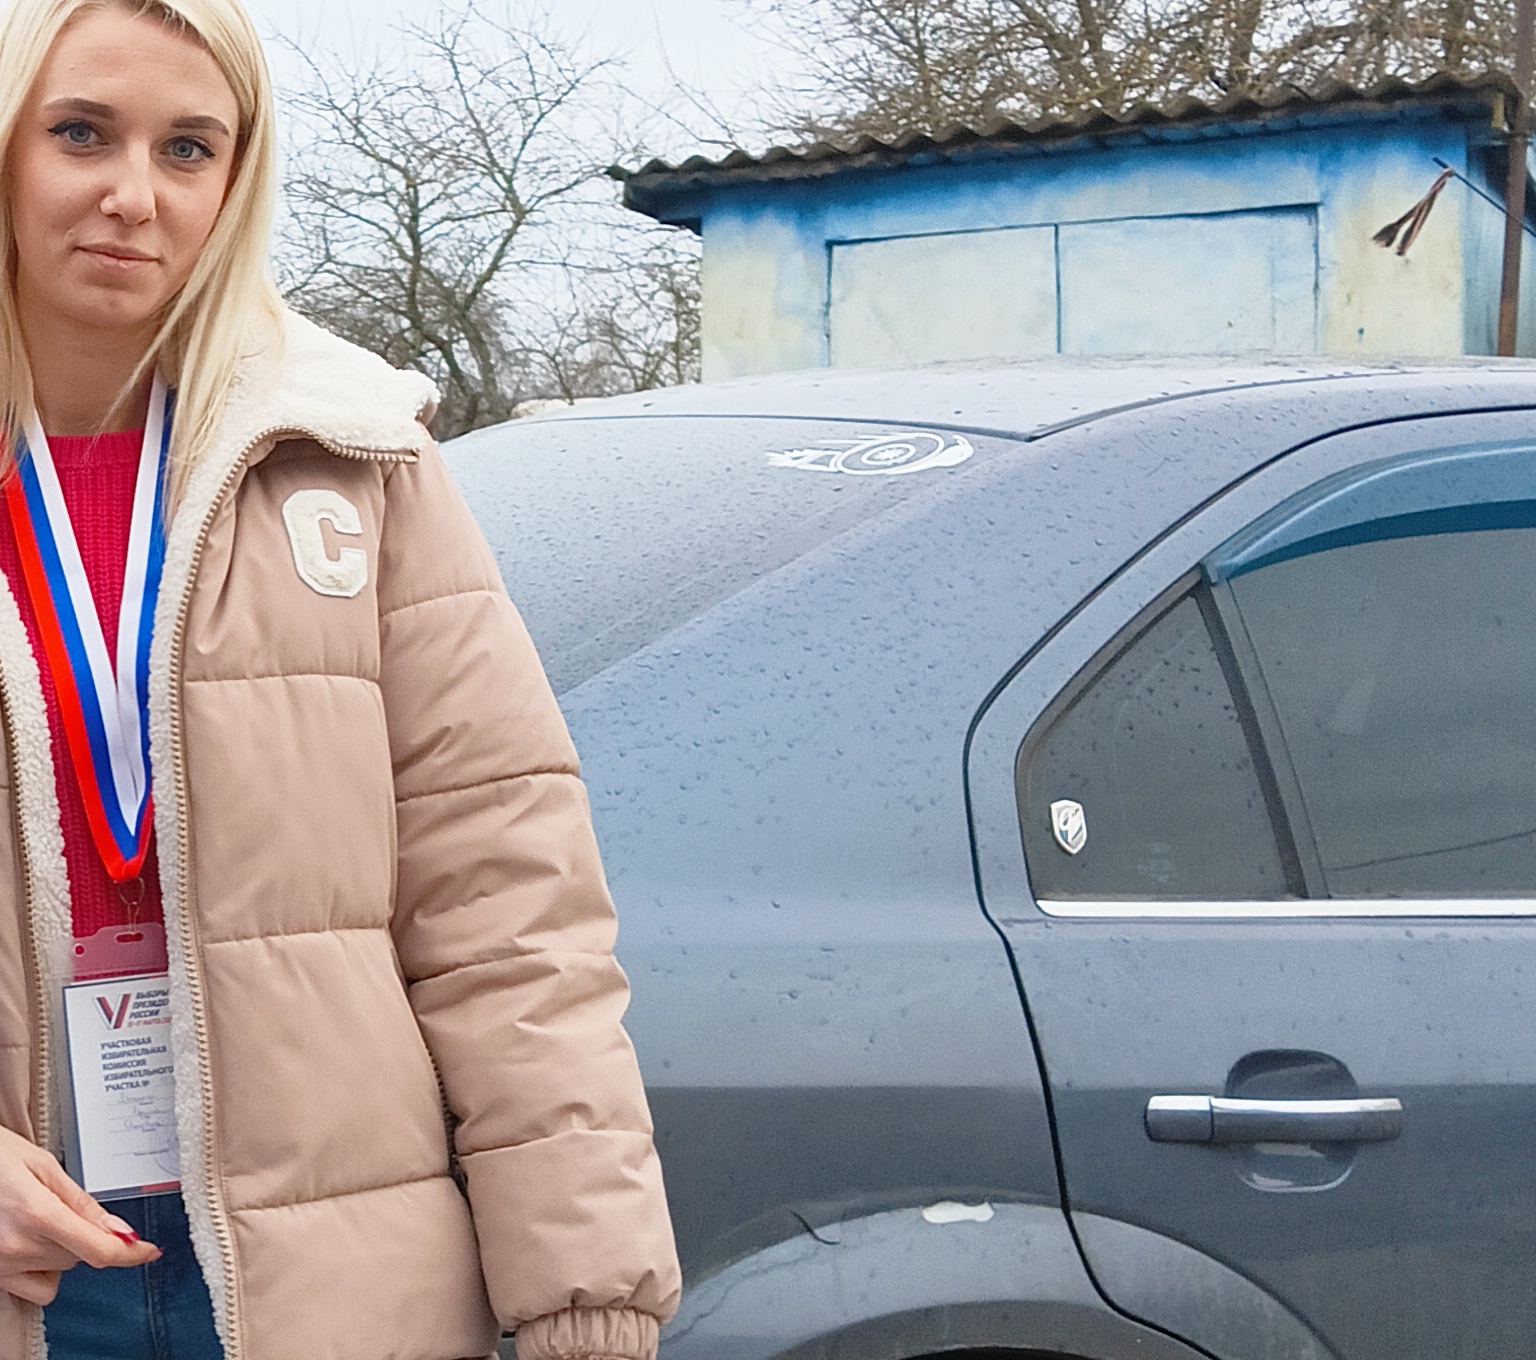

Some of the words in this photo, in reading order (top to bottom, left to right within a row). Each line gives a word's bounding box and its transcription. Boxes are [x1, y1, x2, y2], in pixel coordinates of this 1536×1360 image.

[282, 490, 368, 598] C
[101, 1045, 167, 1060] ИЗБИРАТЕЛЬНАЯ
[102, 1058, 147, 1071] КОМИССИЯ
[103, 1065, 174, 1081] ИЗБИРАТЕЛЬНОГО
[105, 1080, 141, 1092] УЧАСТКА
